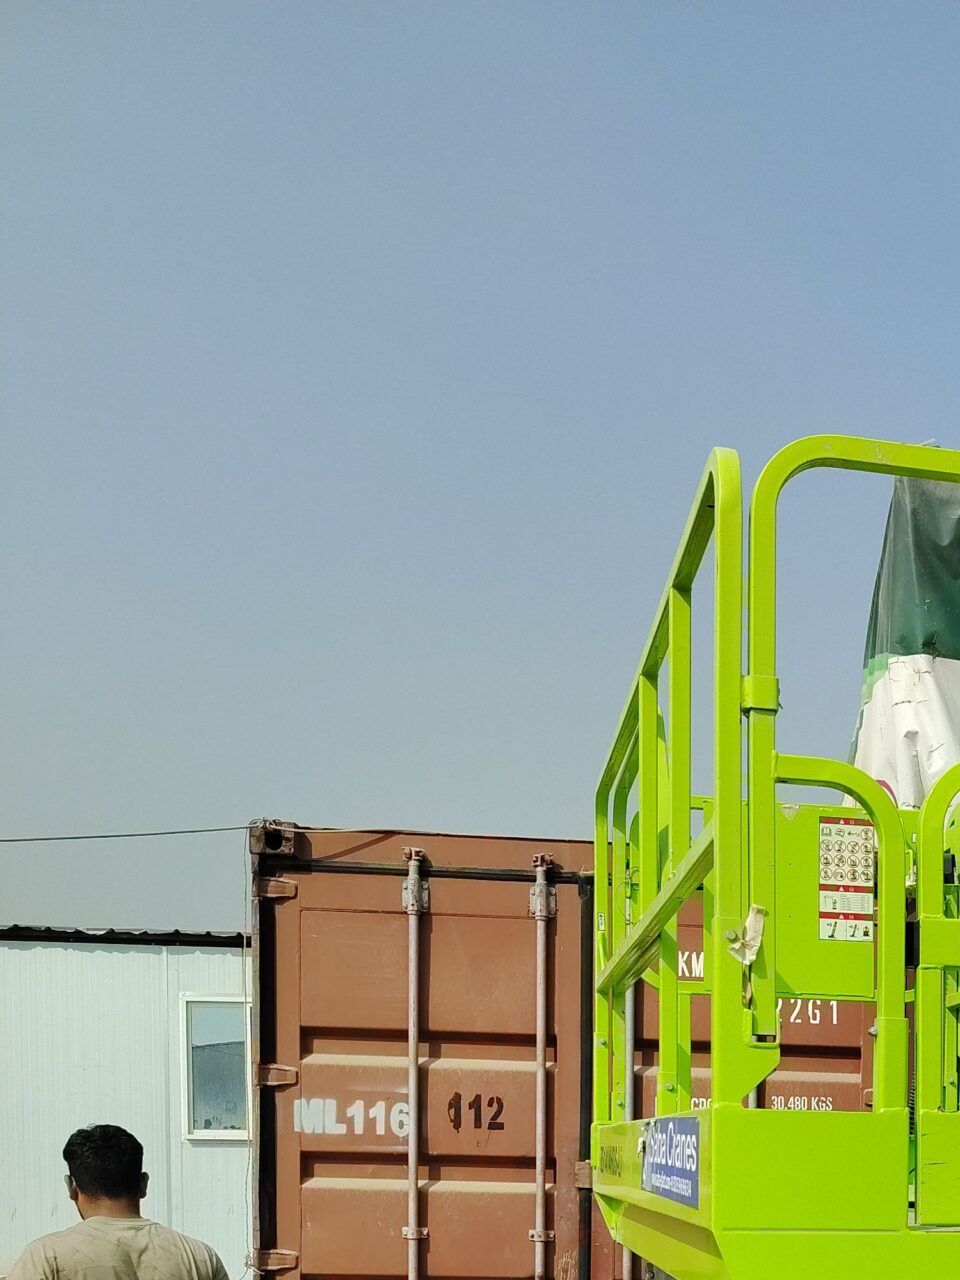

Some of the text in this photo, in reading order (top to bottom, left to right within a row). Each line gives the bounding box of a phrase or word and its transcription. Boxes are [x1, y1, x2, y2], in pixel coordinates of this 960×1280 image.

[293, 1097, 409, 1137] ML116
[811, 1096, 833, 1112] KGS
[667, 1121, 697, 1172] Cranes
